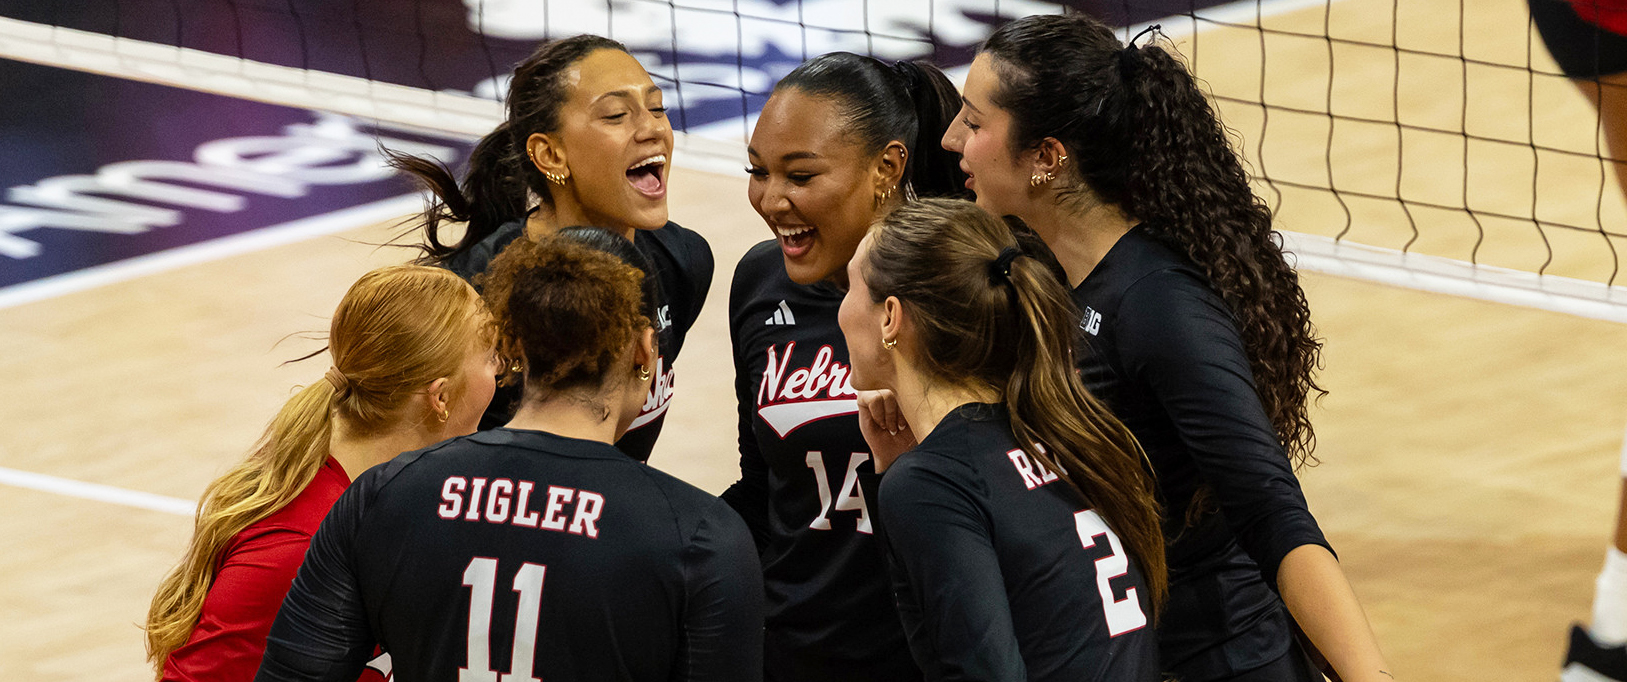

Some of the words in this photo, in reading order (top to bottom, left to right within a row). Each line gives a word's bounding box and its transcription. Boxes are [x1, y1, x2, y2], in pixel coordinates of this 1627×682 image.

[437, 475, 607, 540] SIGLER
[805, 450, 874, 535] 14
[457, 555, 548, 682] 11
[1073, 508, 1148, 639] 2
